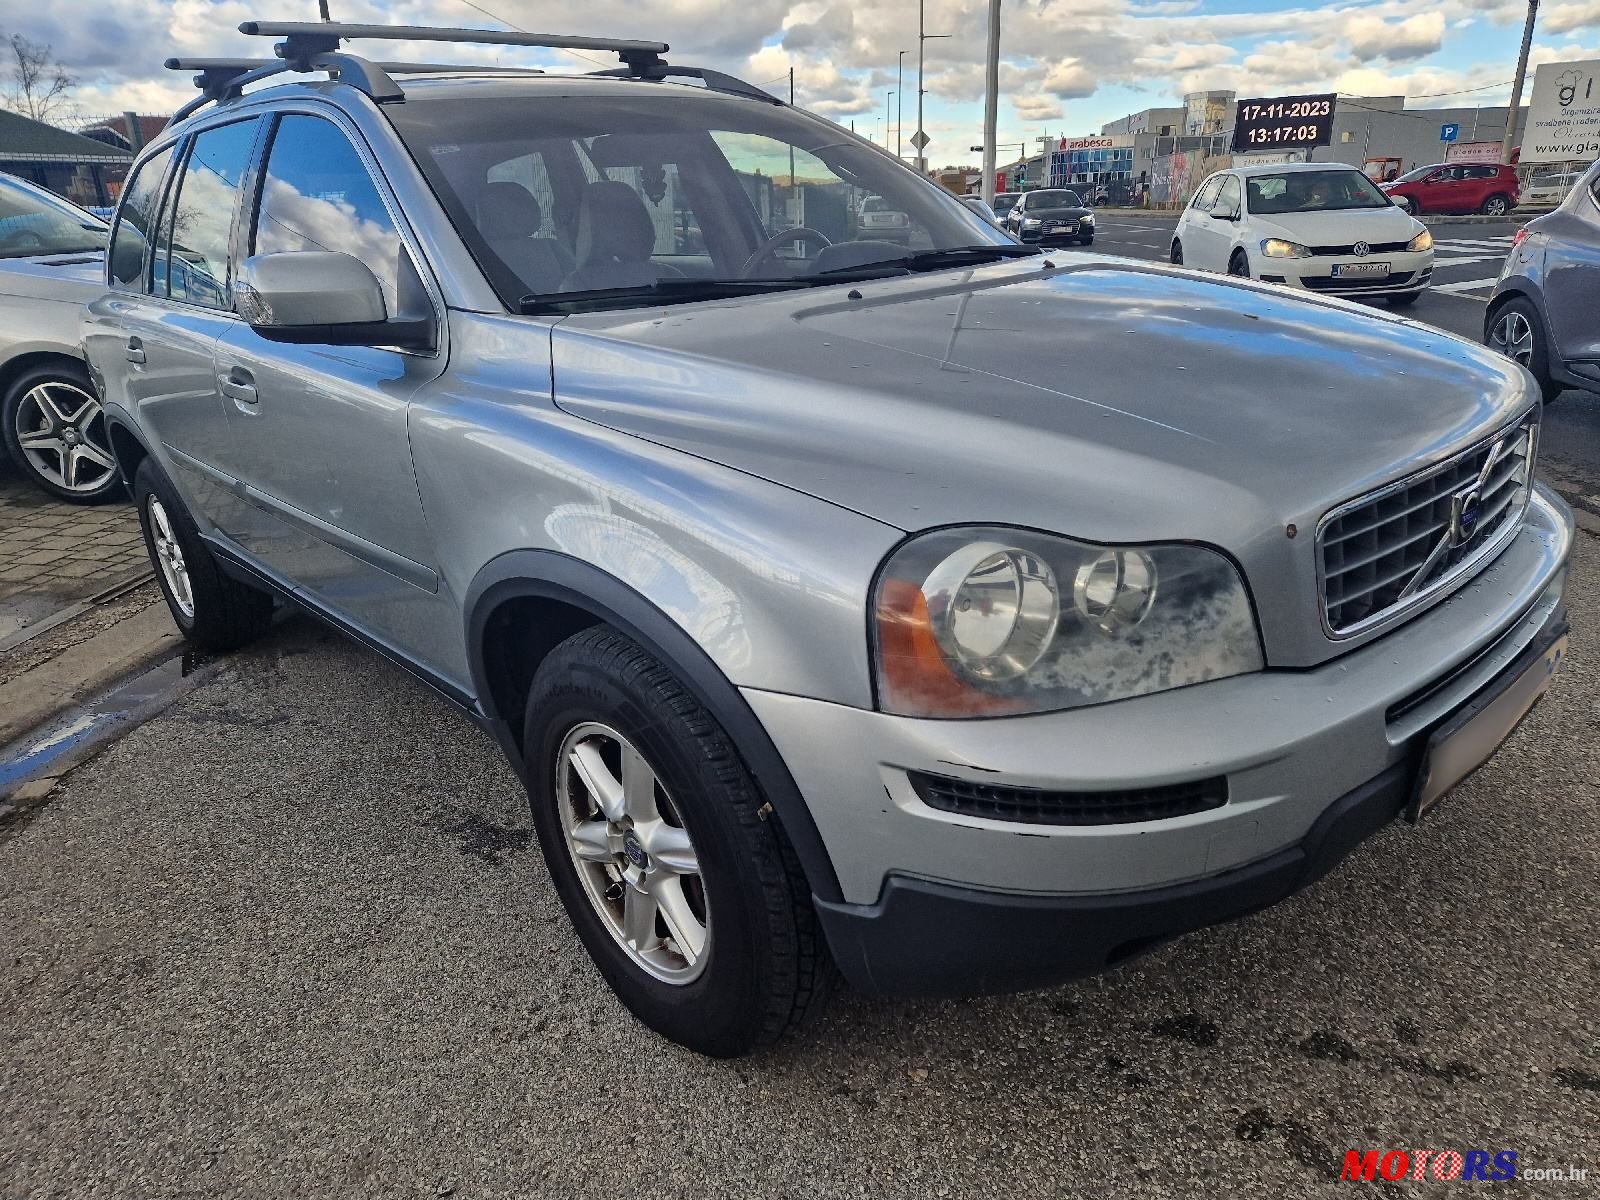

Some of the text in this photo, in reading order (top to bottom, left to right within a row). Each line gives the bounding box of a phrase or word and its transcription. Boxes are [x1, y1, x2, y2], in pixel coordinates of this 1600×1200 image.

[1242, 101, 1330, 120] 17-11-2023
[1248, 125, 1317, 143] 13:17:03
[1445, 127, 1454, 138] P
[1069, 138, 1113, 149] arabesca
